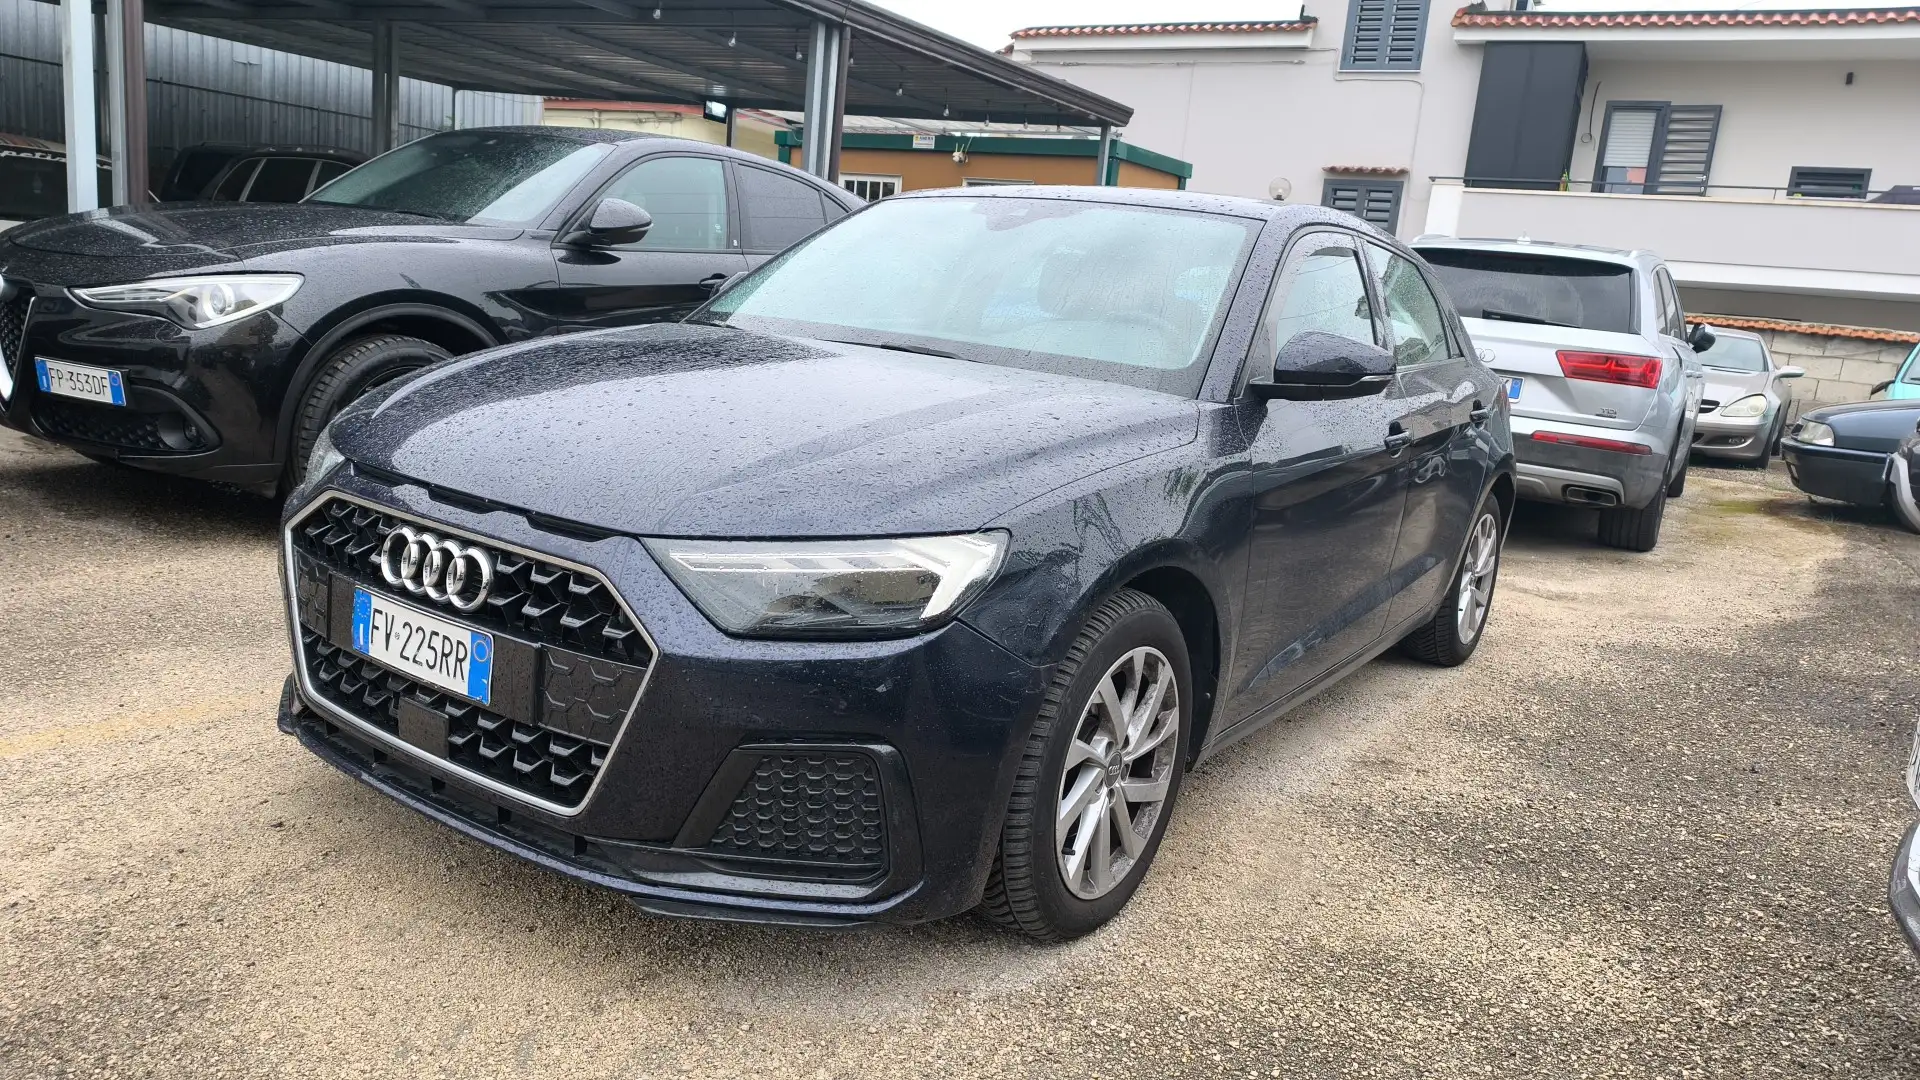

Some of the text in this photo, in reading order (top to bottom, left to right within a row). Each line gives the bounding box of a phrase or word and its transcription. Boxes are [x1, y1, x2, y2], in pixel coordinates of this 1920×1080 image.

[48, 367, 108, 397] FP 353DF
[370, 607, 468, 681] FV 225RR
